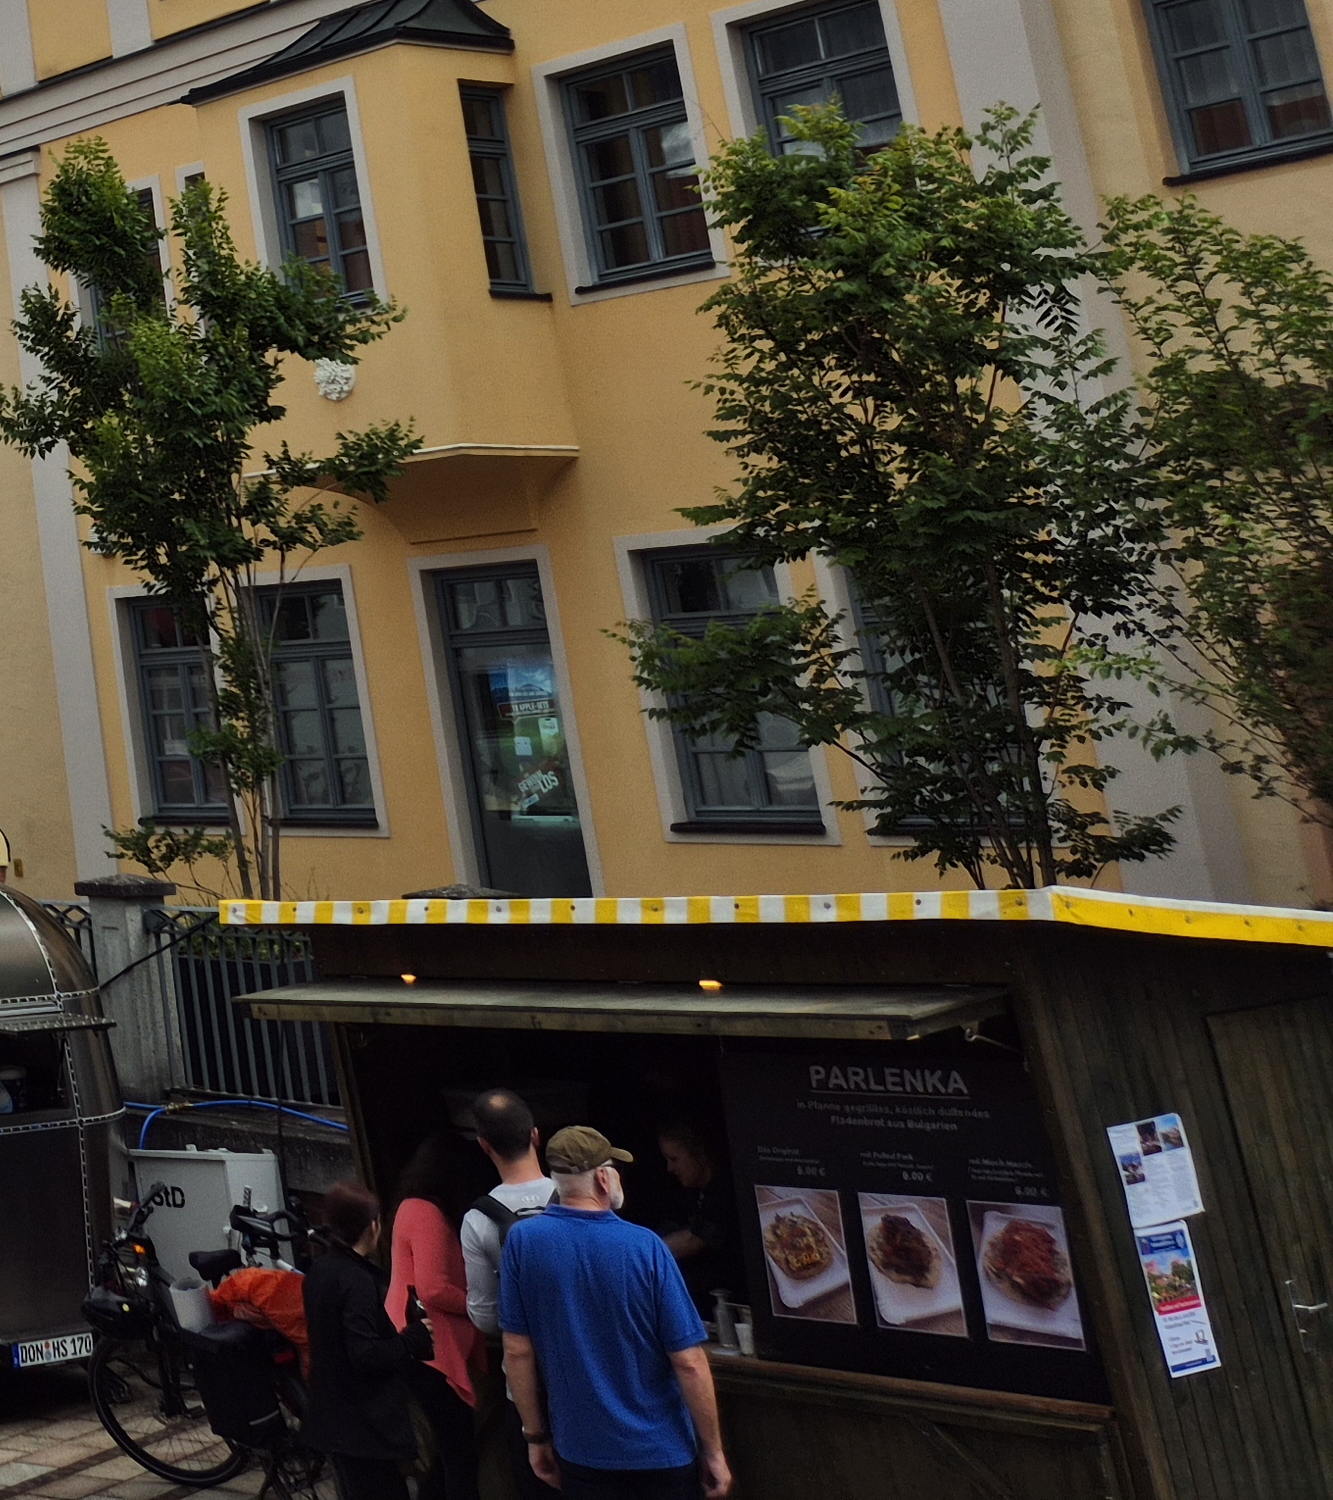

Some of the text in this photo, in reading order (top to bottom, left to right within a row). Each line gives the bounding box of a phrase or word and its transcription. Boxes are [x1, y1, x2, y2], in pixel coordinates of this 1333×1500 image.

[538, 771, 559, 793] LOS
[809, 1065, 968, 1094] PARLENKA
[20, 1335, 92, 1363] DON HS 170
